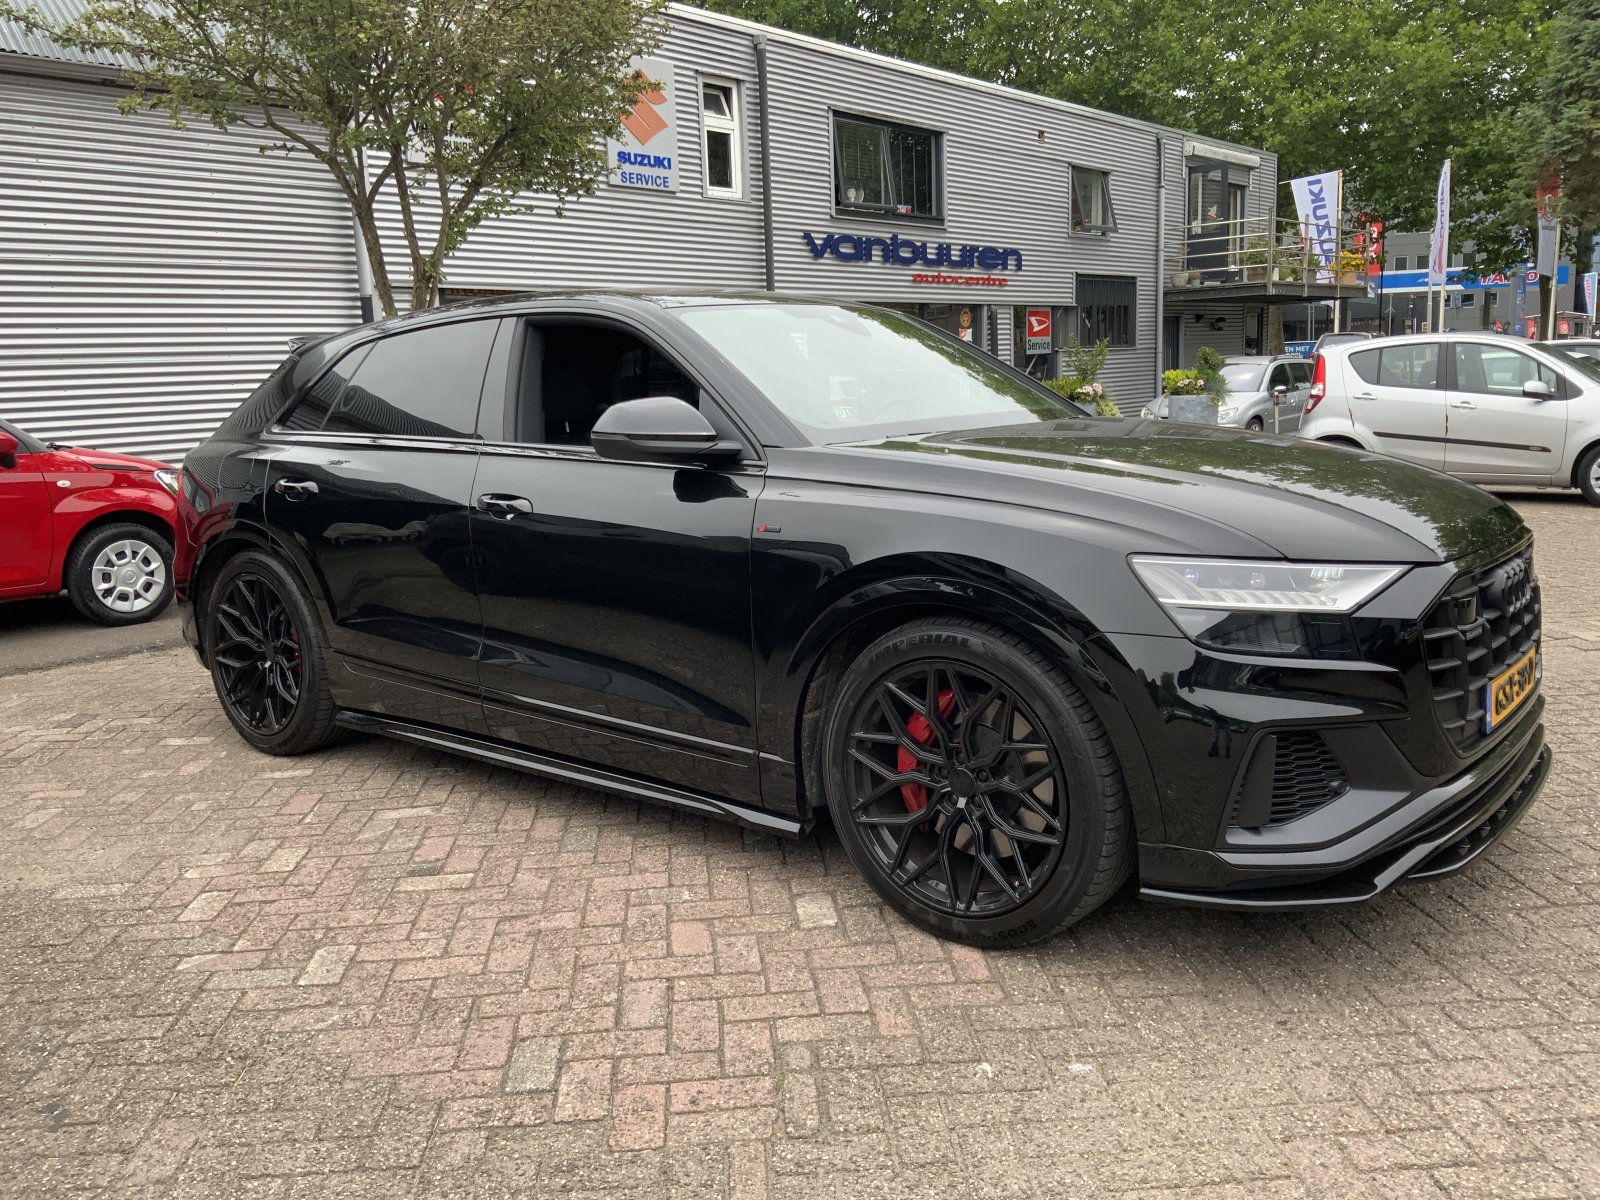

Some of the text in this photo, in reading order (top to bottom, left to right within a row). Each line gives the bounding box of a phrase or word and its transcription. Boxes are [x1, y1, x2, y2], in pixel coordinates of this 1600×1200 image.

[616, 150, 672, 170] SUZUKI
[620, 171, 670, 188] SERVICE
[802, 231, 1023, 272] vanbuuren
[912, 272, 1008, 288] autocentre
[1027, 339, 1051, 351] Service
